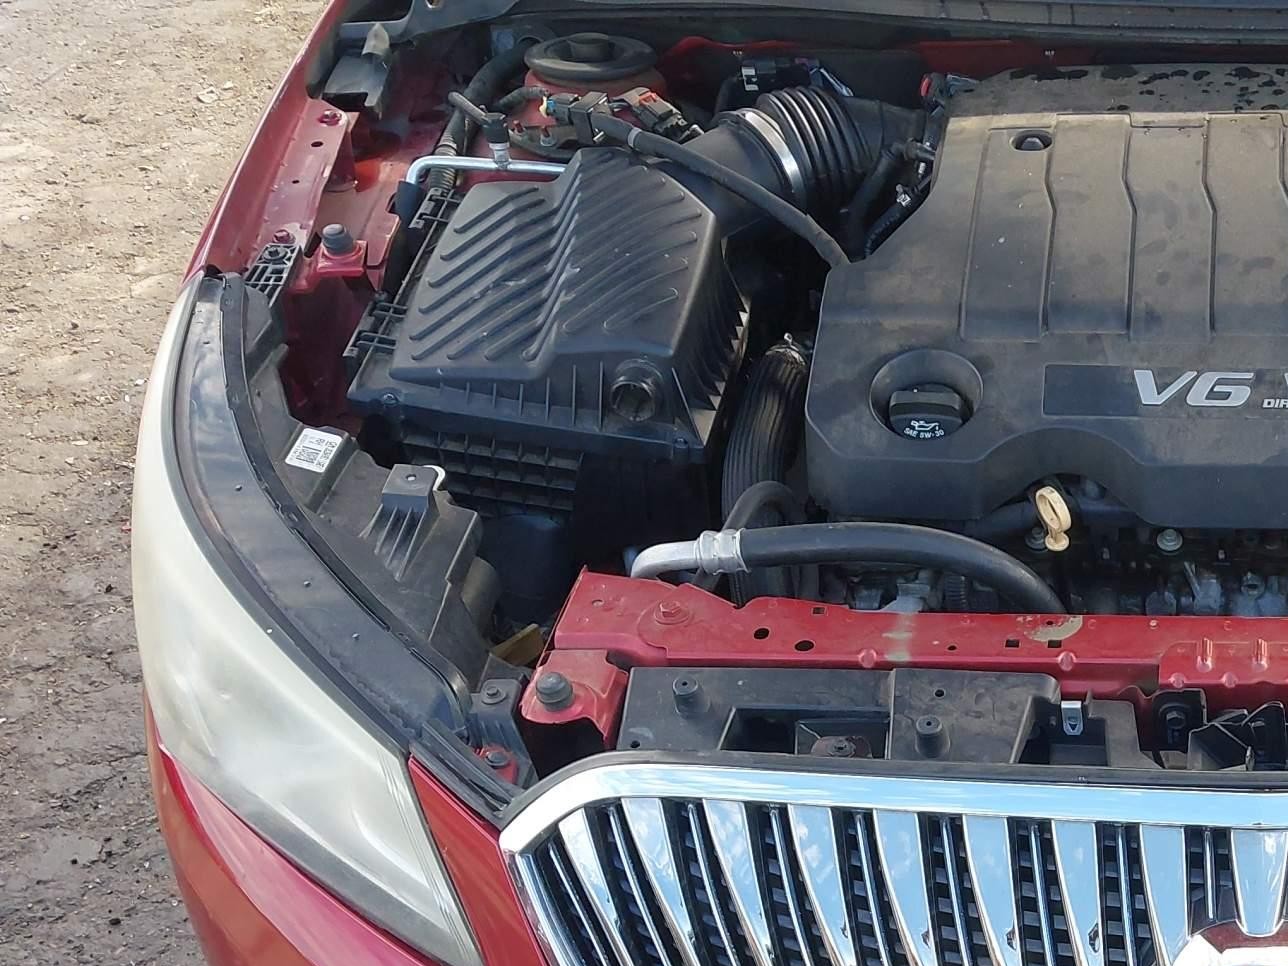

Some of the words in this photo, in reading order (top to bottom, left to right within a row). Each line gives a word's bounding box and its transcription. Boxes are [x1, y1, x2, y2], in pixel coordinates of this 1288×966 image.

[1133, 369, 1254, 407] V6
[904, 428, 918, 438] SAE
[919, 429, 945, 439] 5W-30
